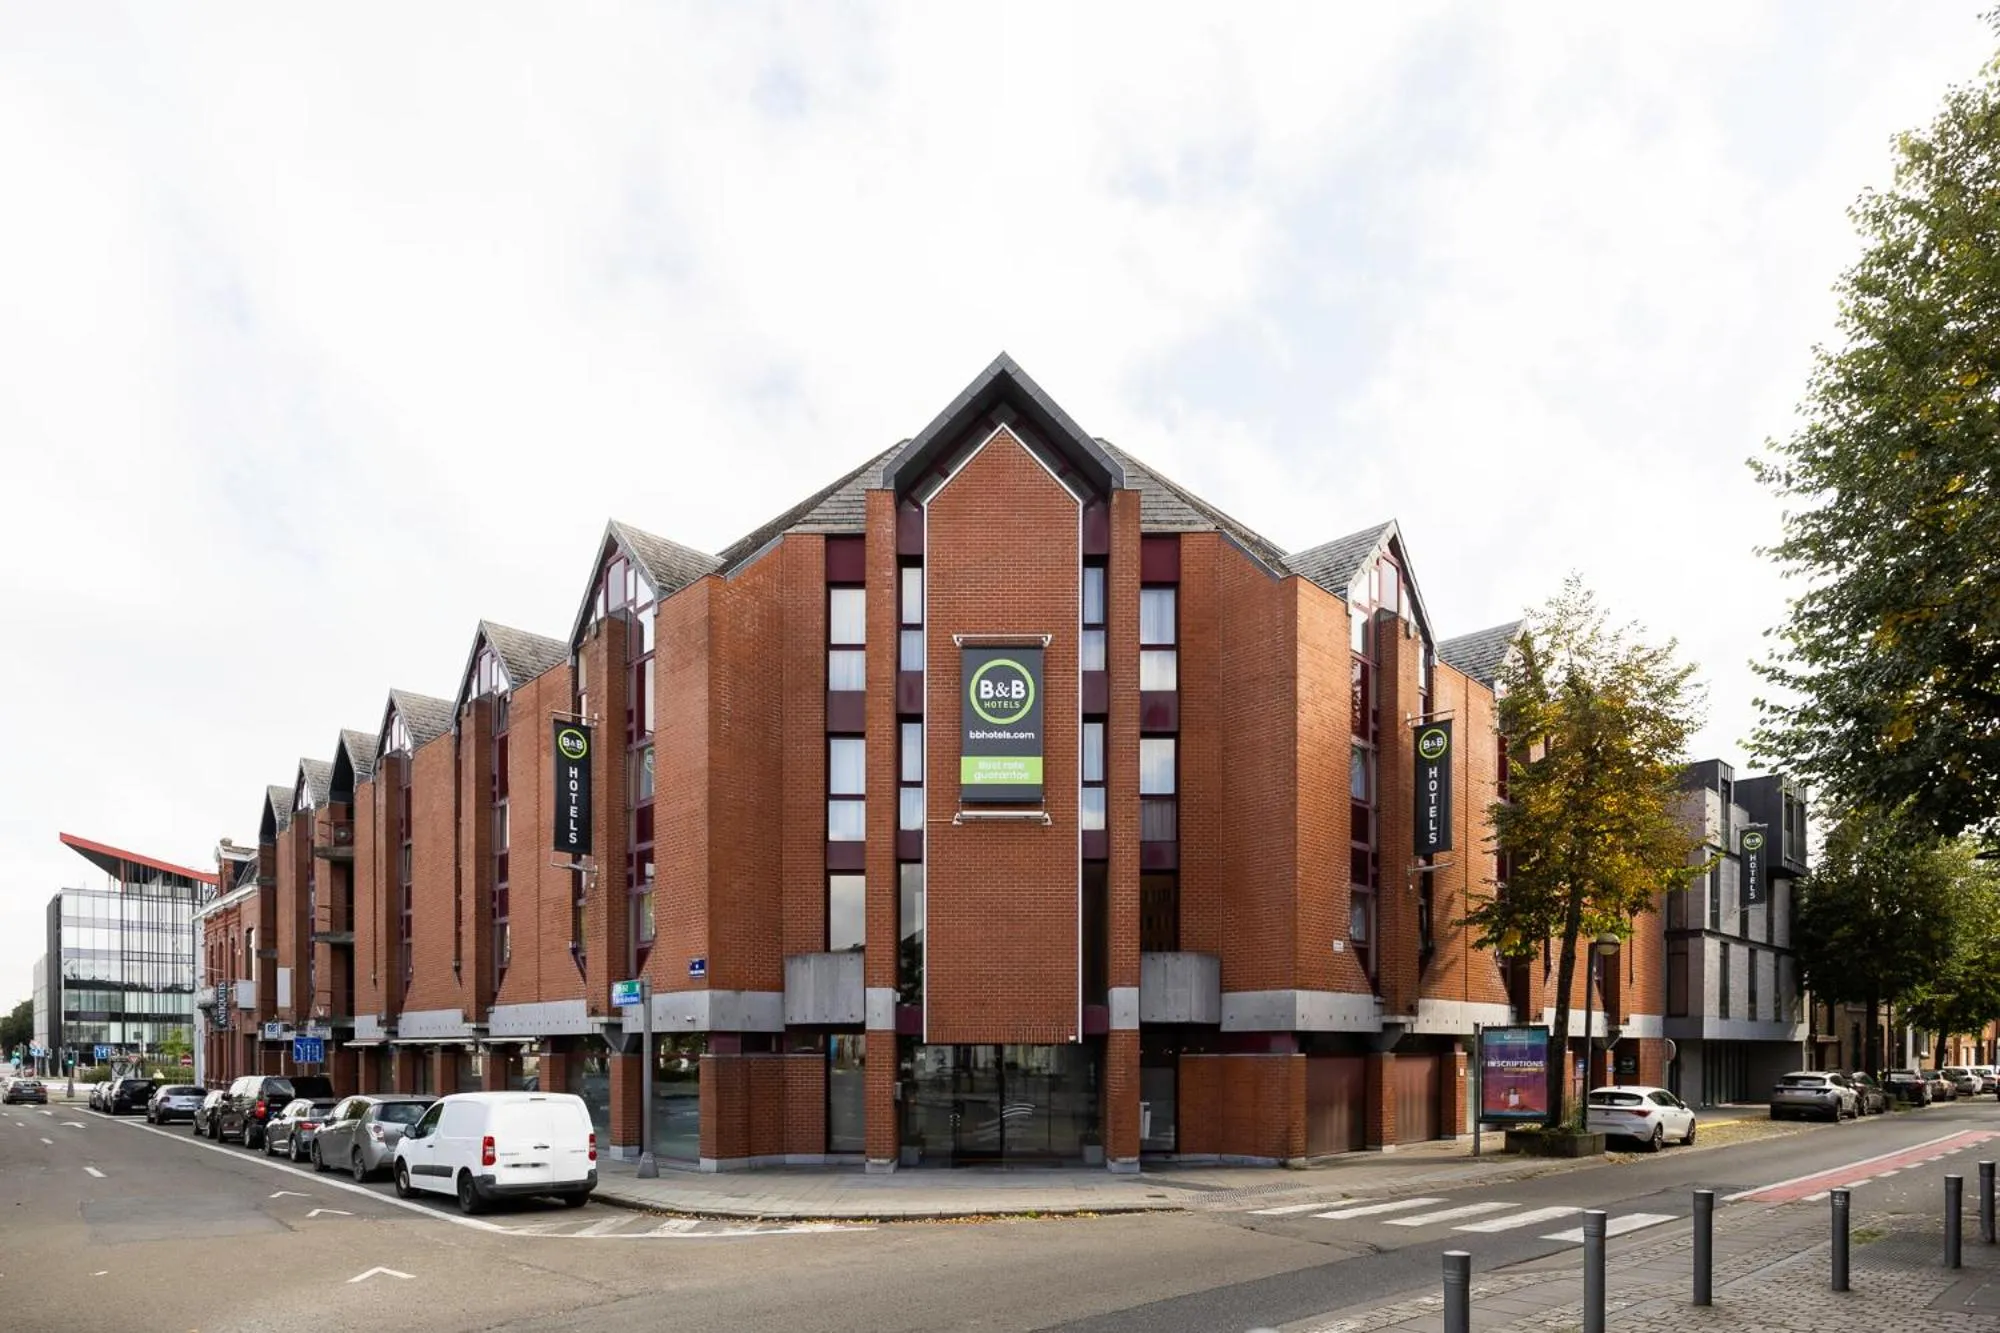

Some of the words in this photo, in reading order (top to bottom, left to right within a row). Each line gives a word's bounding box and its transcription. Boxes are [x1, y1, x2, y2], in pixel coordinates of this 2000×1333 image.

[980, 679, 1026, 699] B&B
[984, 700, 1020, 709] HOTELS
[969, 730, 1035, 740] bbhotels.com
[562, 736, 584, 750] B&B
[1423, 736, 1444, 750] B&B
[569, 766, 578, 844] HOTELS
[1428, 766, 1437, 844] HOTELS
